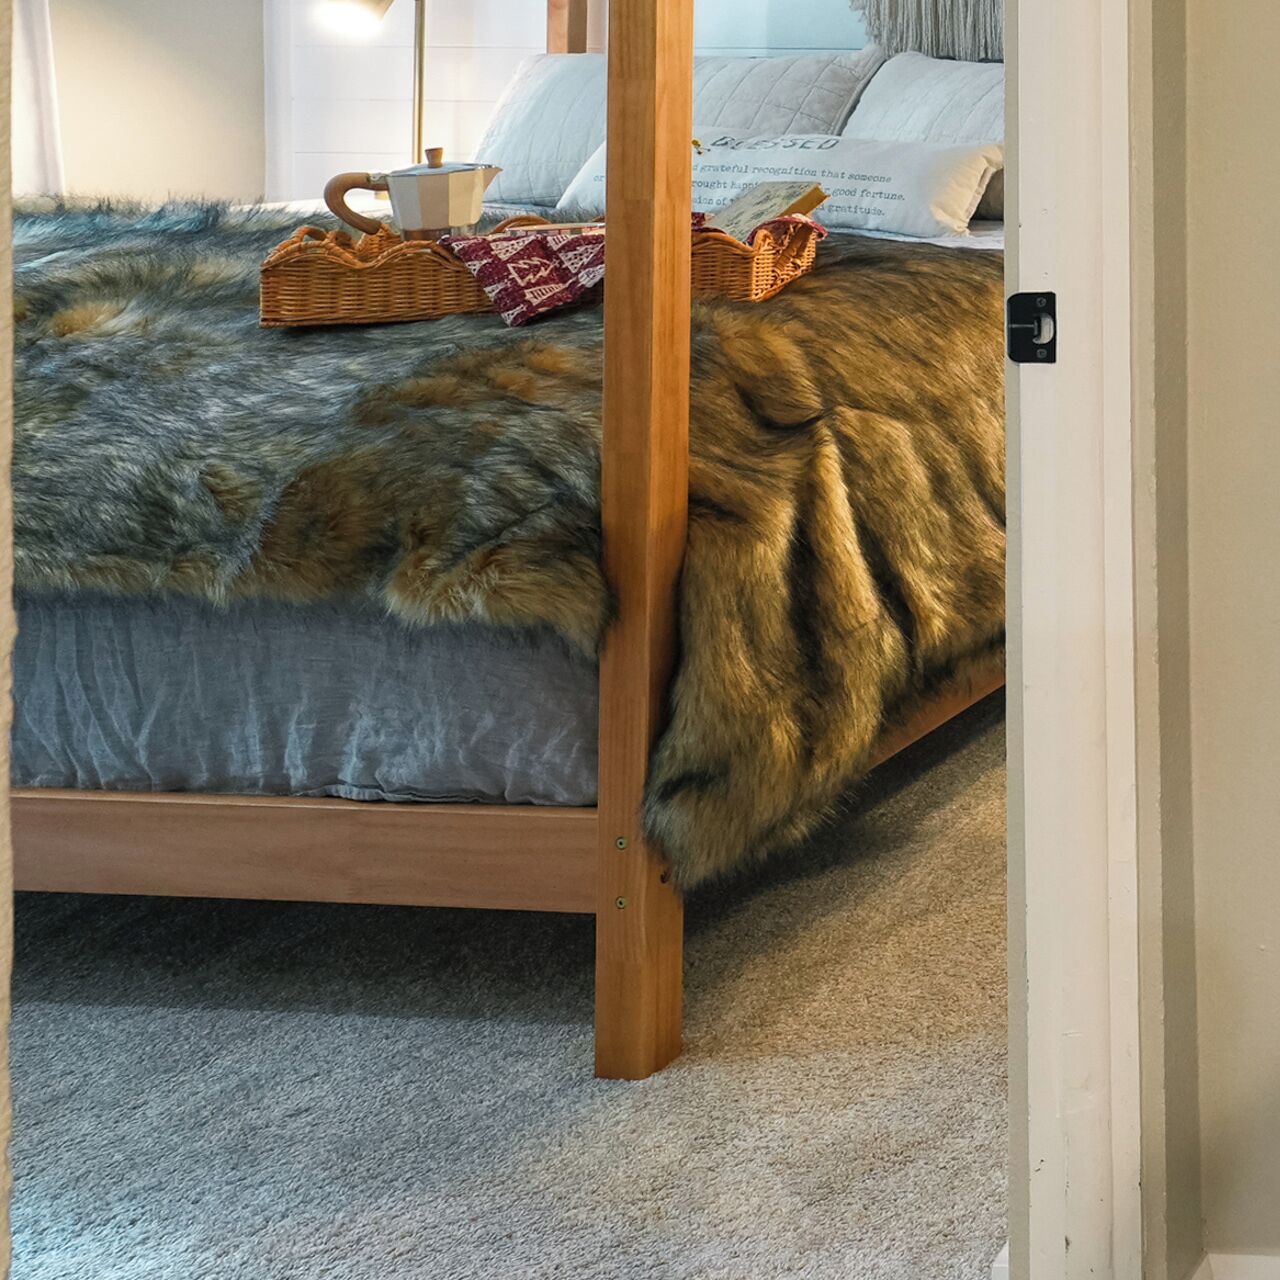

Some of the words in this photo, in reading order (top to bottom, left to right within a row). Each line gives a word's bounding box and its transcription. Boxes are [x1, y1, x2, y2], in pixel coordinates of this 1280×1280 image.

[710, 136, 840, 150] BLESSED
[700, 164, 748, 174] grateful
[752, 165, 817, 177] recognition
[821, 169, 845, 179] that
[847, 173, 892, 183] someone
[692, 180, 727, 190] rought
[832, 187, 857, 197] good
